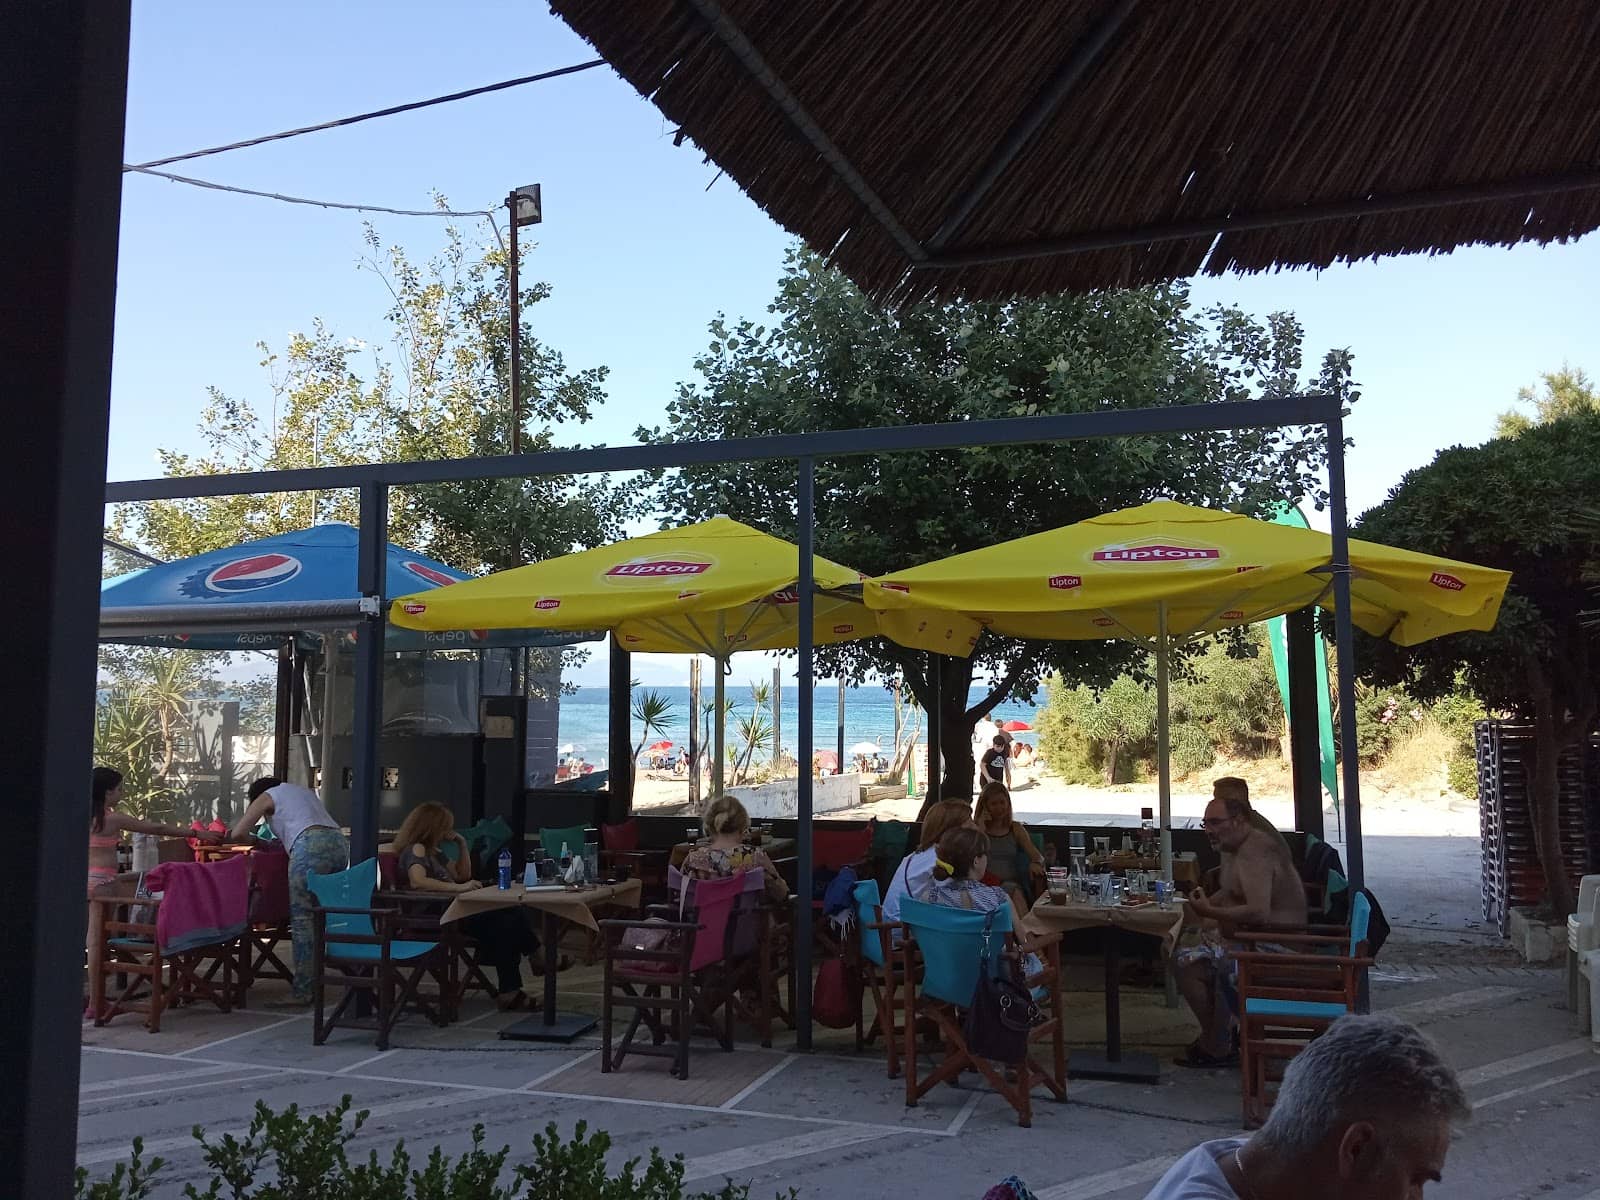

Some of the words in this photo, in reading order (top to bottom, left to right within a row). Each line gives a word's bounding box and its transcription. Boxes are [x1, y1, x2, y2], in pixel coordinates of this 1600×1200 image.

[1104, 548, 1209, 560] Lipton
[616, 565, 700, 575] Lipton
[1051, 577, 1079, 587] Lipton
[1433, 575, 1462, 590] Lipton
[537, 600, 559, 609] Lipton
